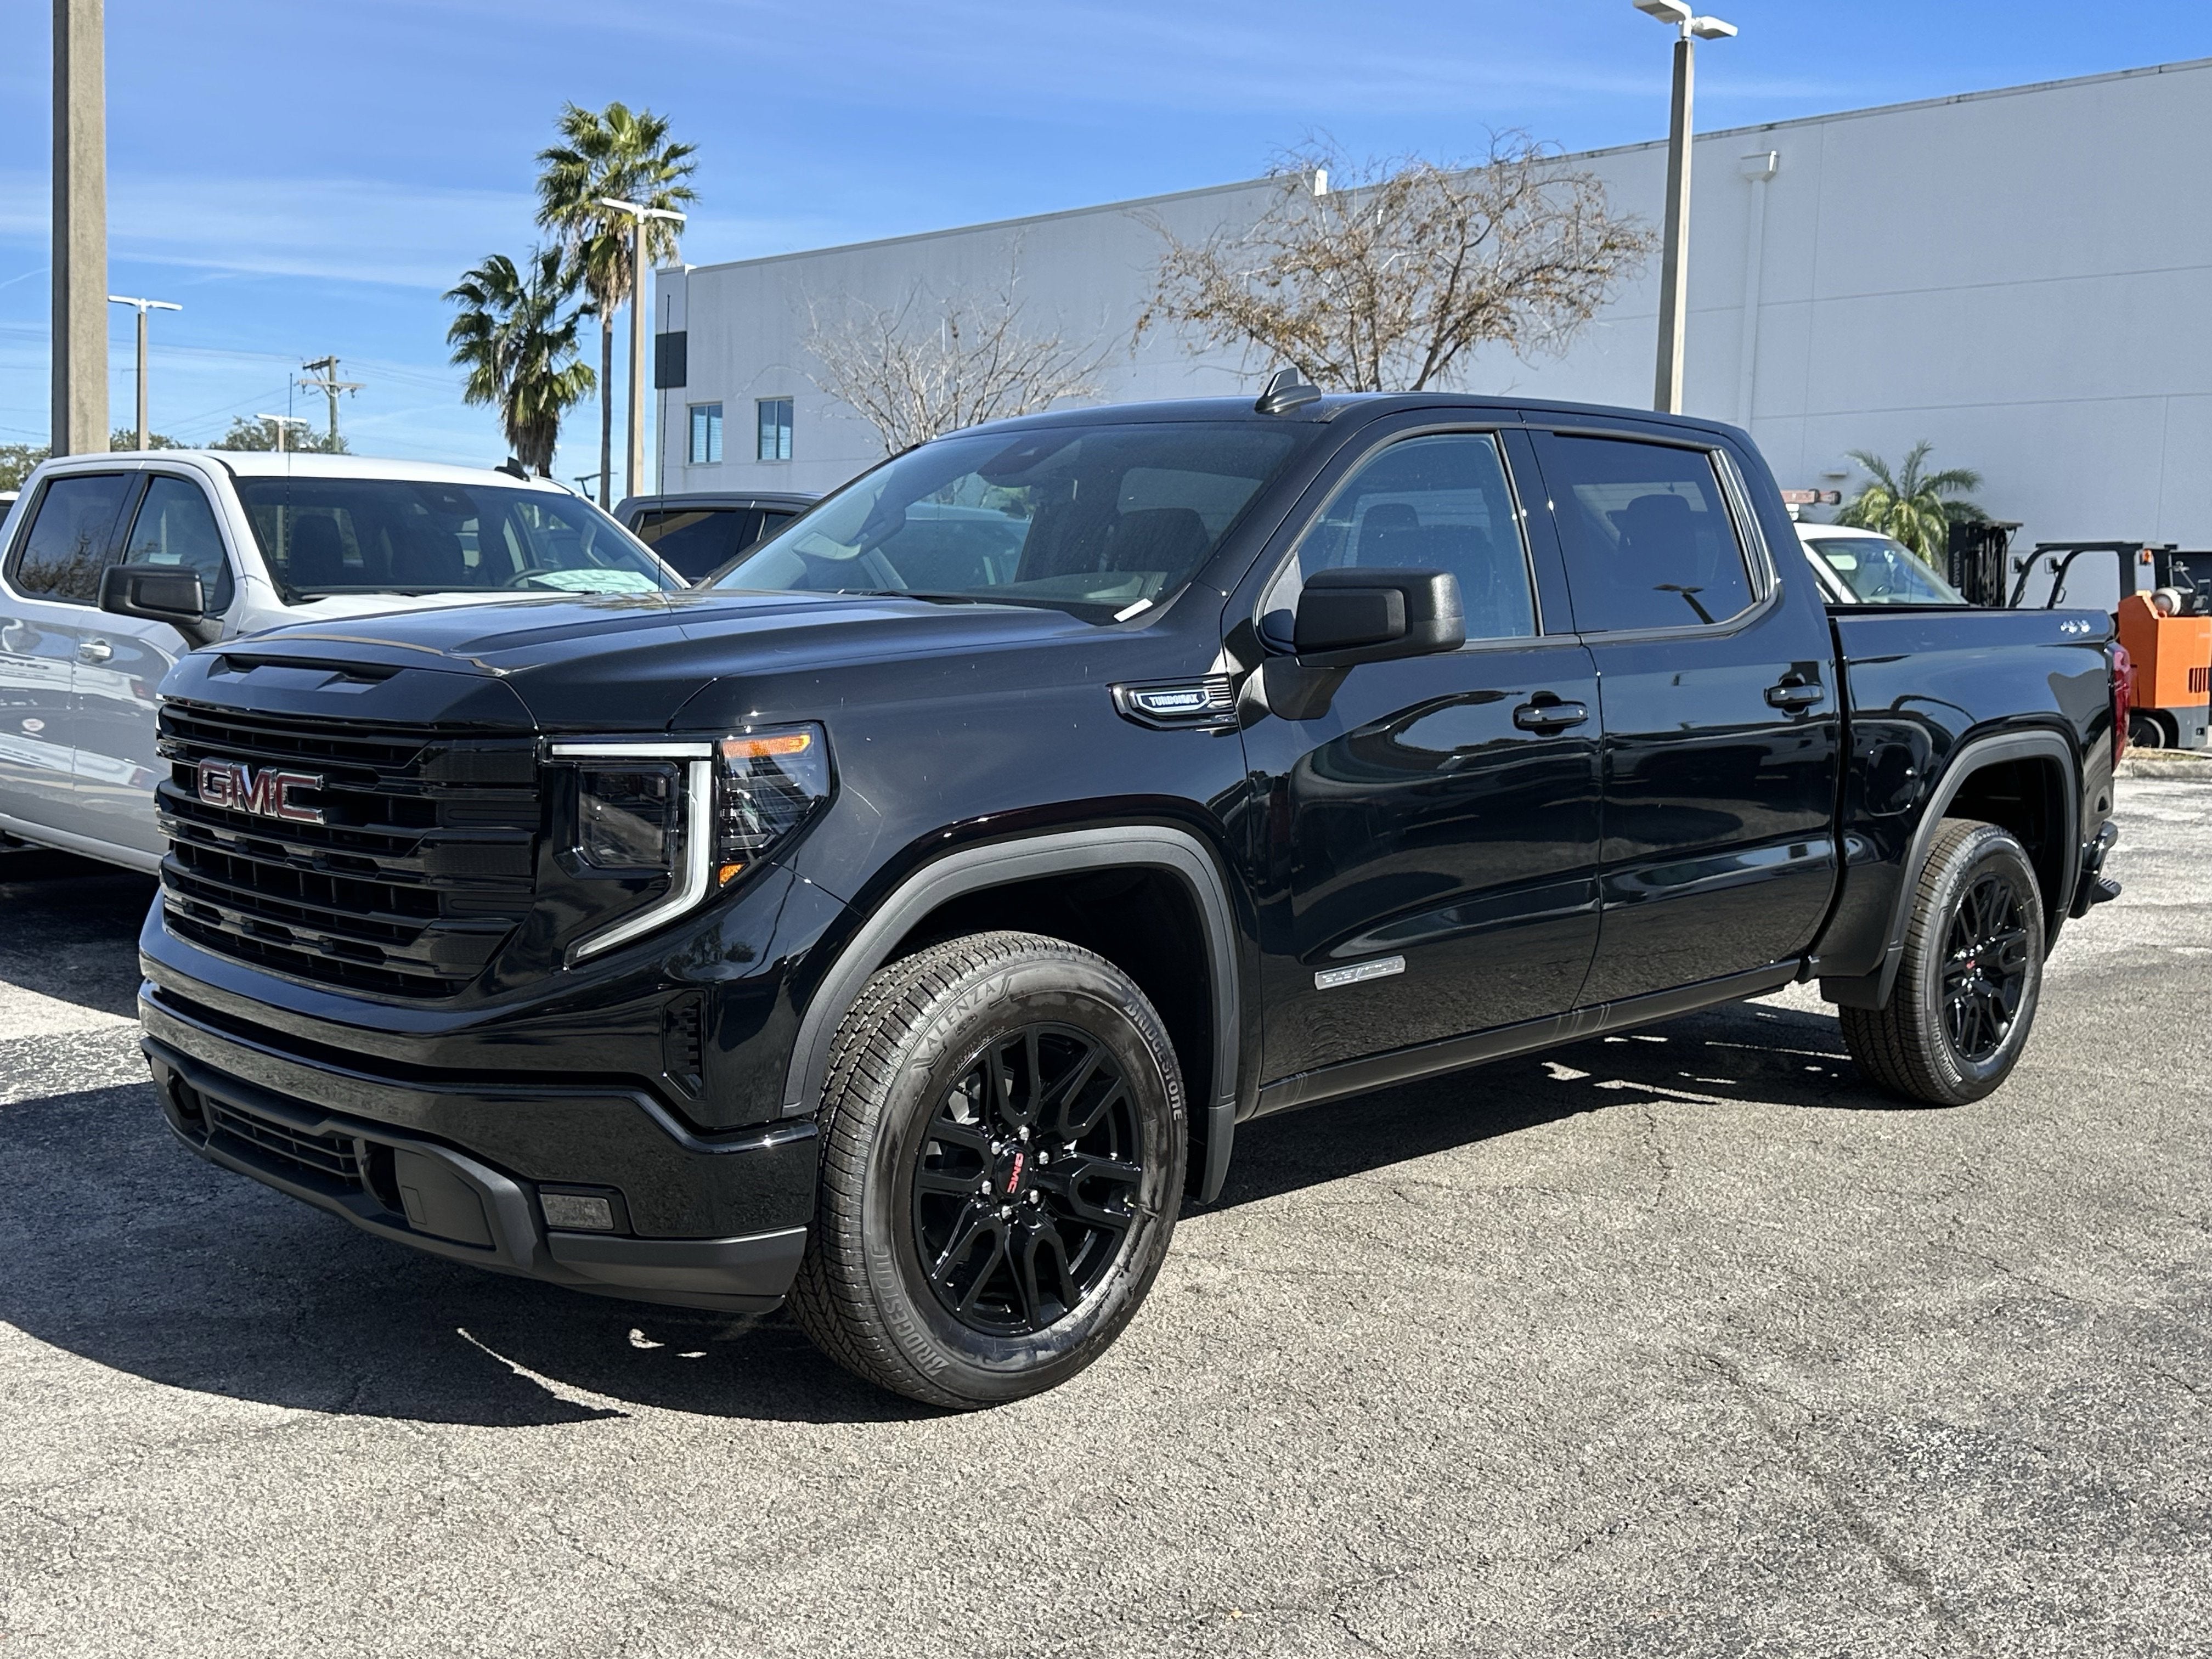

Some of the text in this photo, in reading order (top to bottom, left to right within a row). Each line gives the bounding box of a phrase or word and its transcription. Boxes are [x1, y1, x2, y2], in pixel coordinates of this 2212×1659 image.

[198, 756, 326, 825] GMC
[926, 982, 996, 1052] ALENZA
[1123, 998, 1183, 1121] BRIDGESTONE
[1007, 1153, 1024, 1194] GMC
[870, 1244, 950, 1376] BRIDGESTONE
